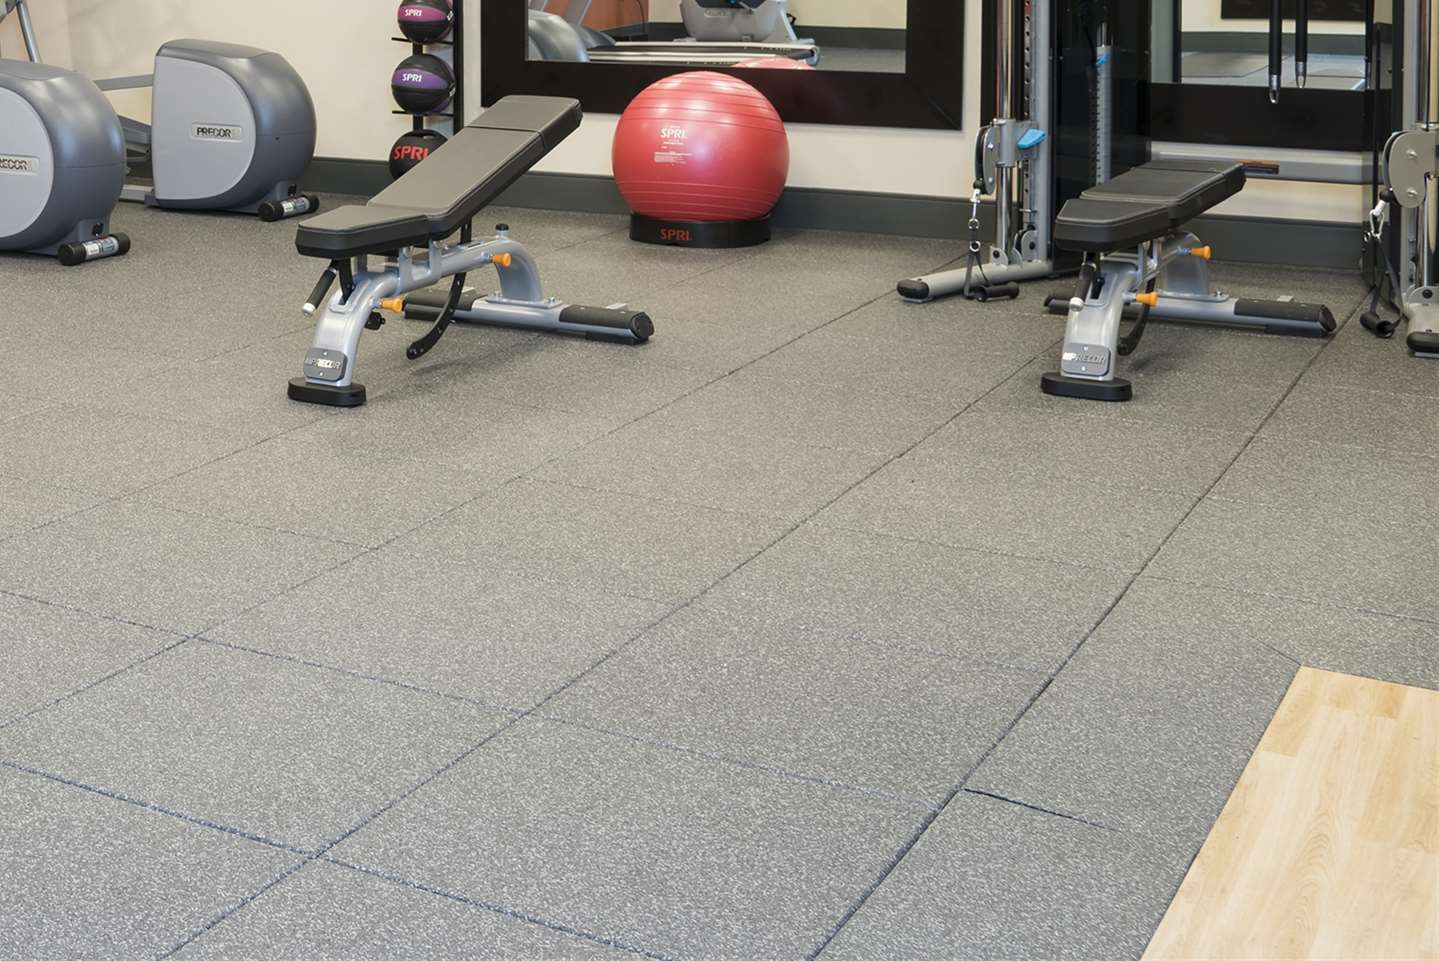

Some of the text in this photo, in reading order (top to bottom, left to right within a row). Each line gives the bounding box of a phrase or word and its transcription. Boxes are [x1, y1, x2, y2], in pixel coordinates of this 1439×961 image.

[405, 8, 423, 17] SPRI
[402, 73, 423, 82] SPRI
[196, 126, 232, 138] PRECOR
[393, 145, 428, 160] SPRI
[660, 228, 689, 241] SPRI
